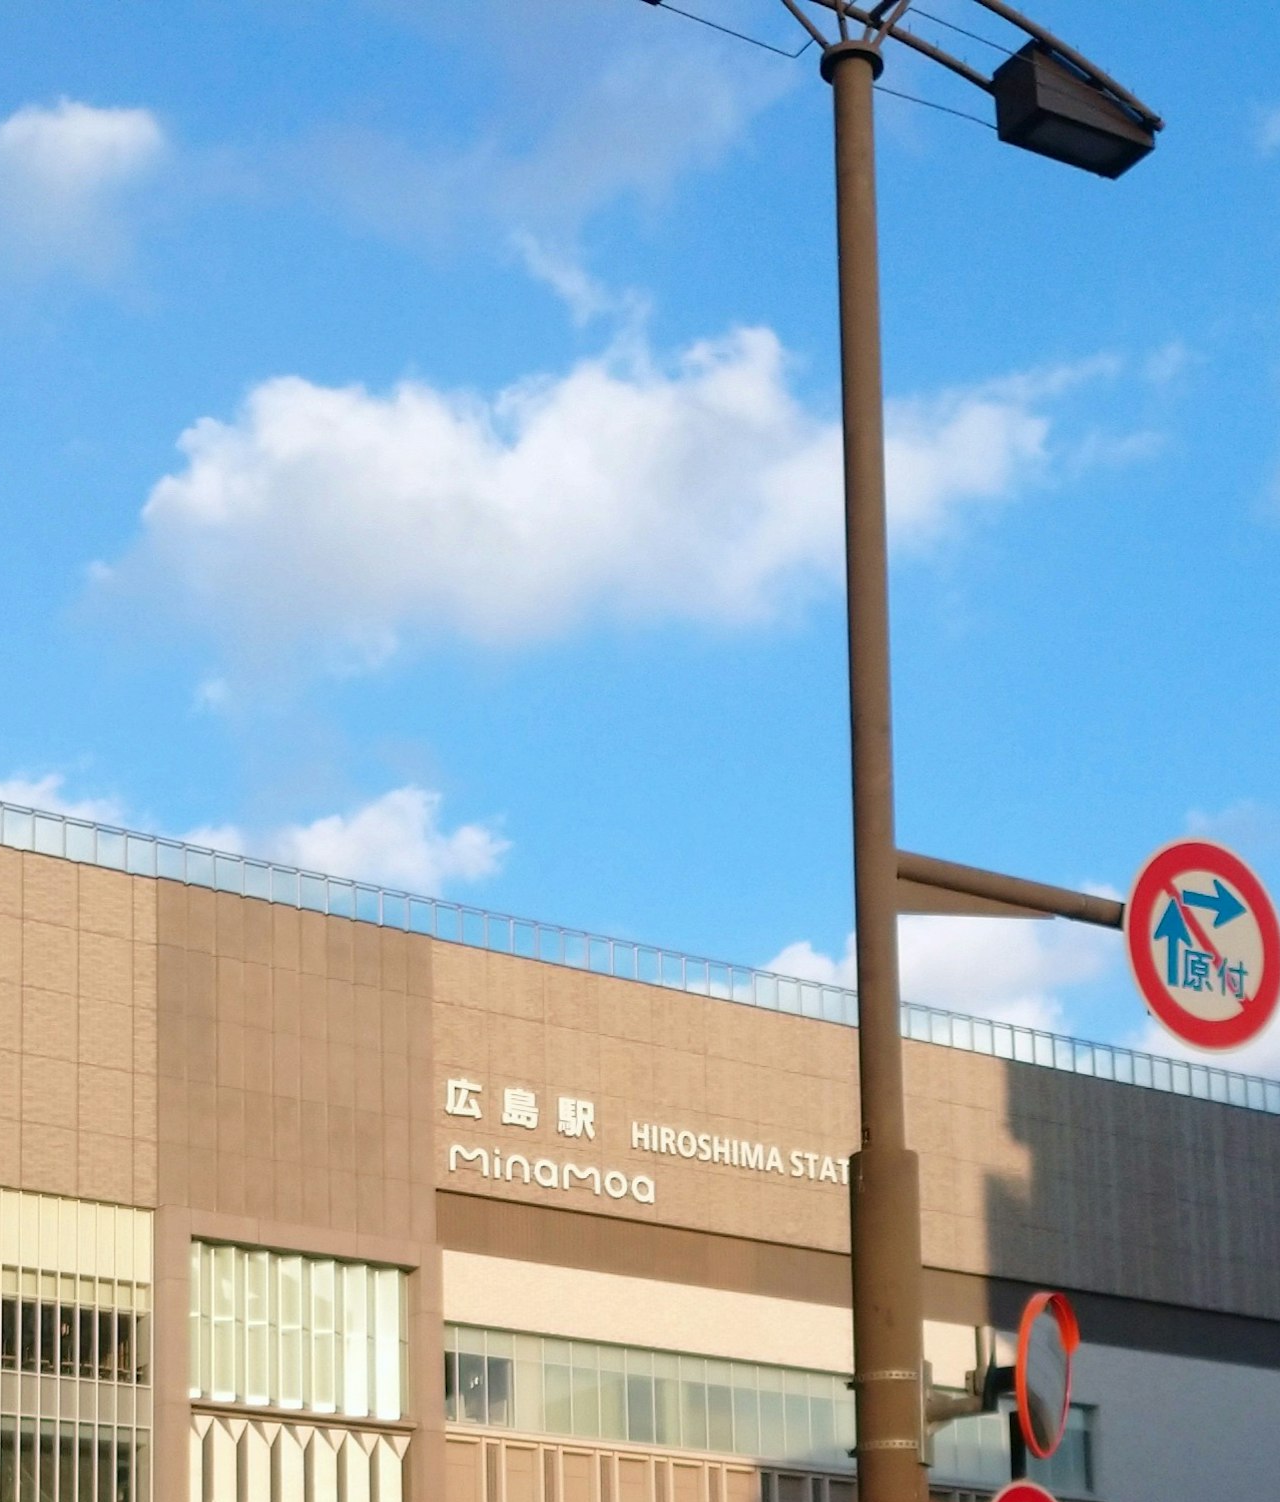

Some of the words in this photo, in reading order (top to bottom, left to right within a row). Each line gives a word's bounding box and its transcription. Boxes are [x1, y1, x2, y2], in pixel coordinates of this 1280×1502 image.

[1183, 950, 1249, 998] 原付
[445, 1078, 596, 1140] 広島駅
[631, 1120, 784, 1174] HIROSHIMA
